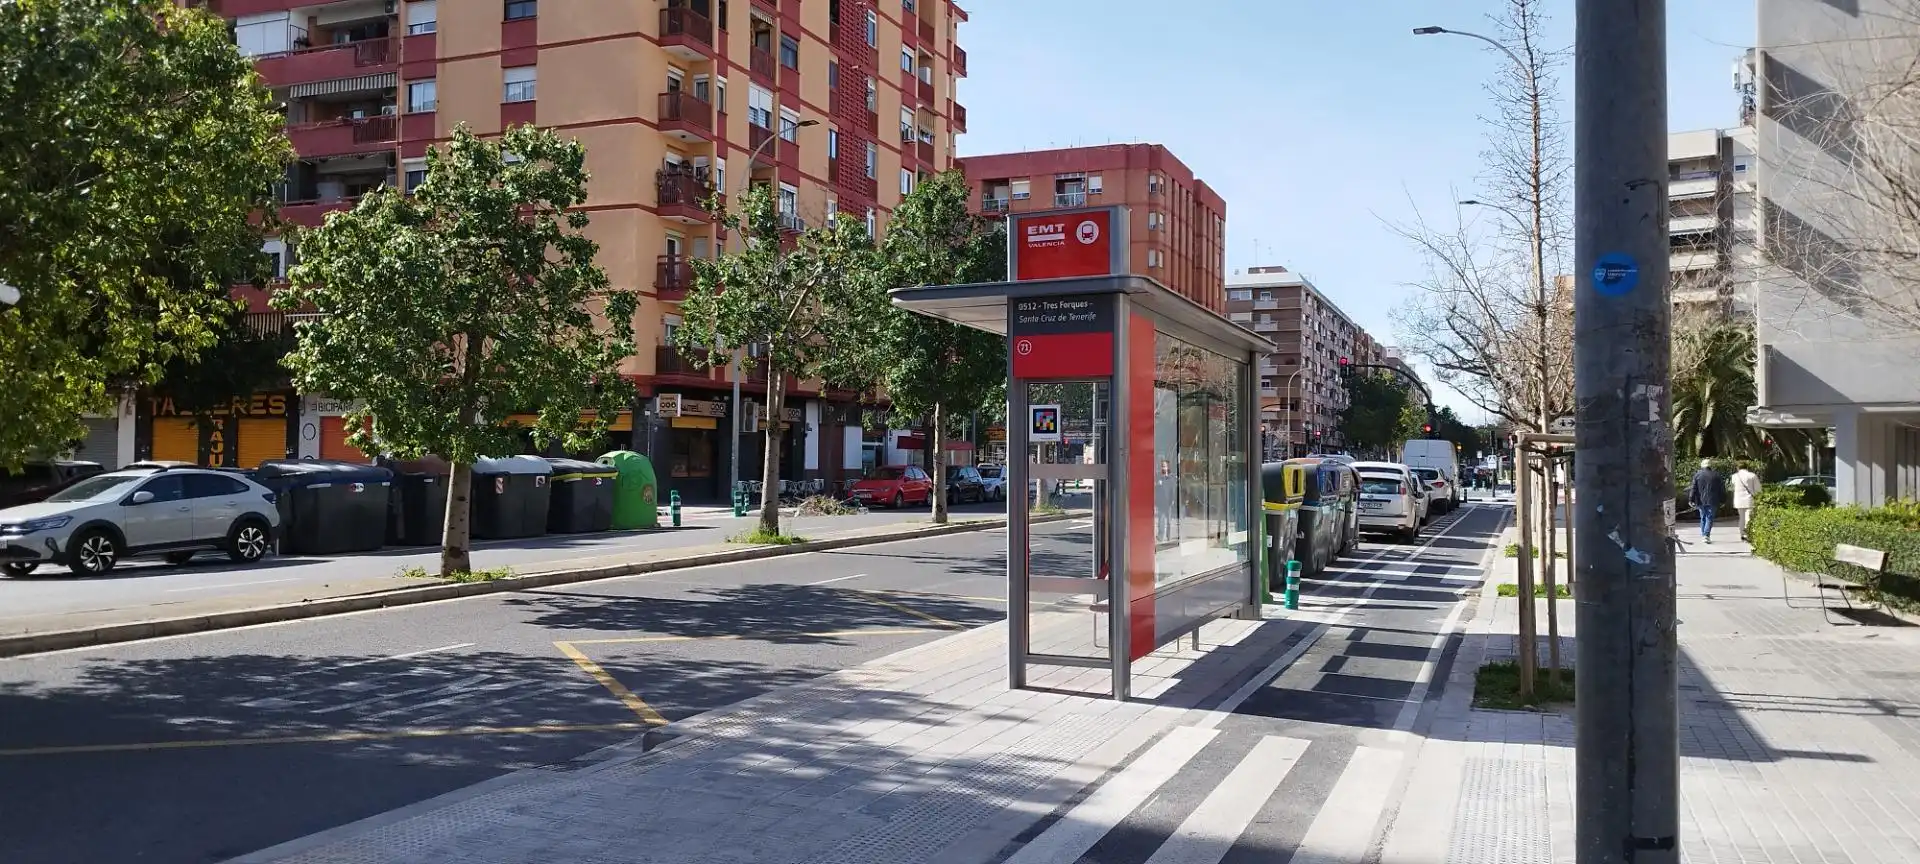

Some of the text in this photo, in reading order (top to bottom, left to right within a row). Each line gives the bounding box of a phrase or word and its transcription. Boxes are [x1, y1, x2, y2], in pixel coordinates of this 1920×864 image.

[1028, 224, 1065, 235] EMT
[1018, 302, 1037, 311] 0512
[1043, 301, 1058, 310] Tres
[1059, 300, 1089, 310] Forques
[1019, 311, 1097, 324] Santa Cruz de Tenerife
